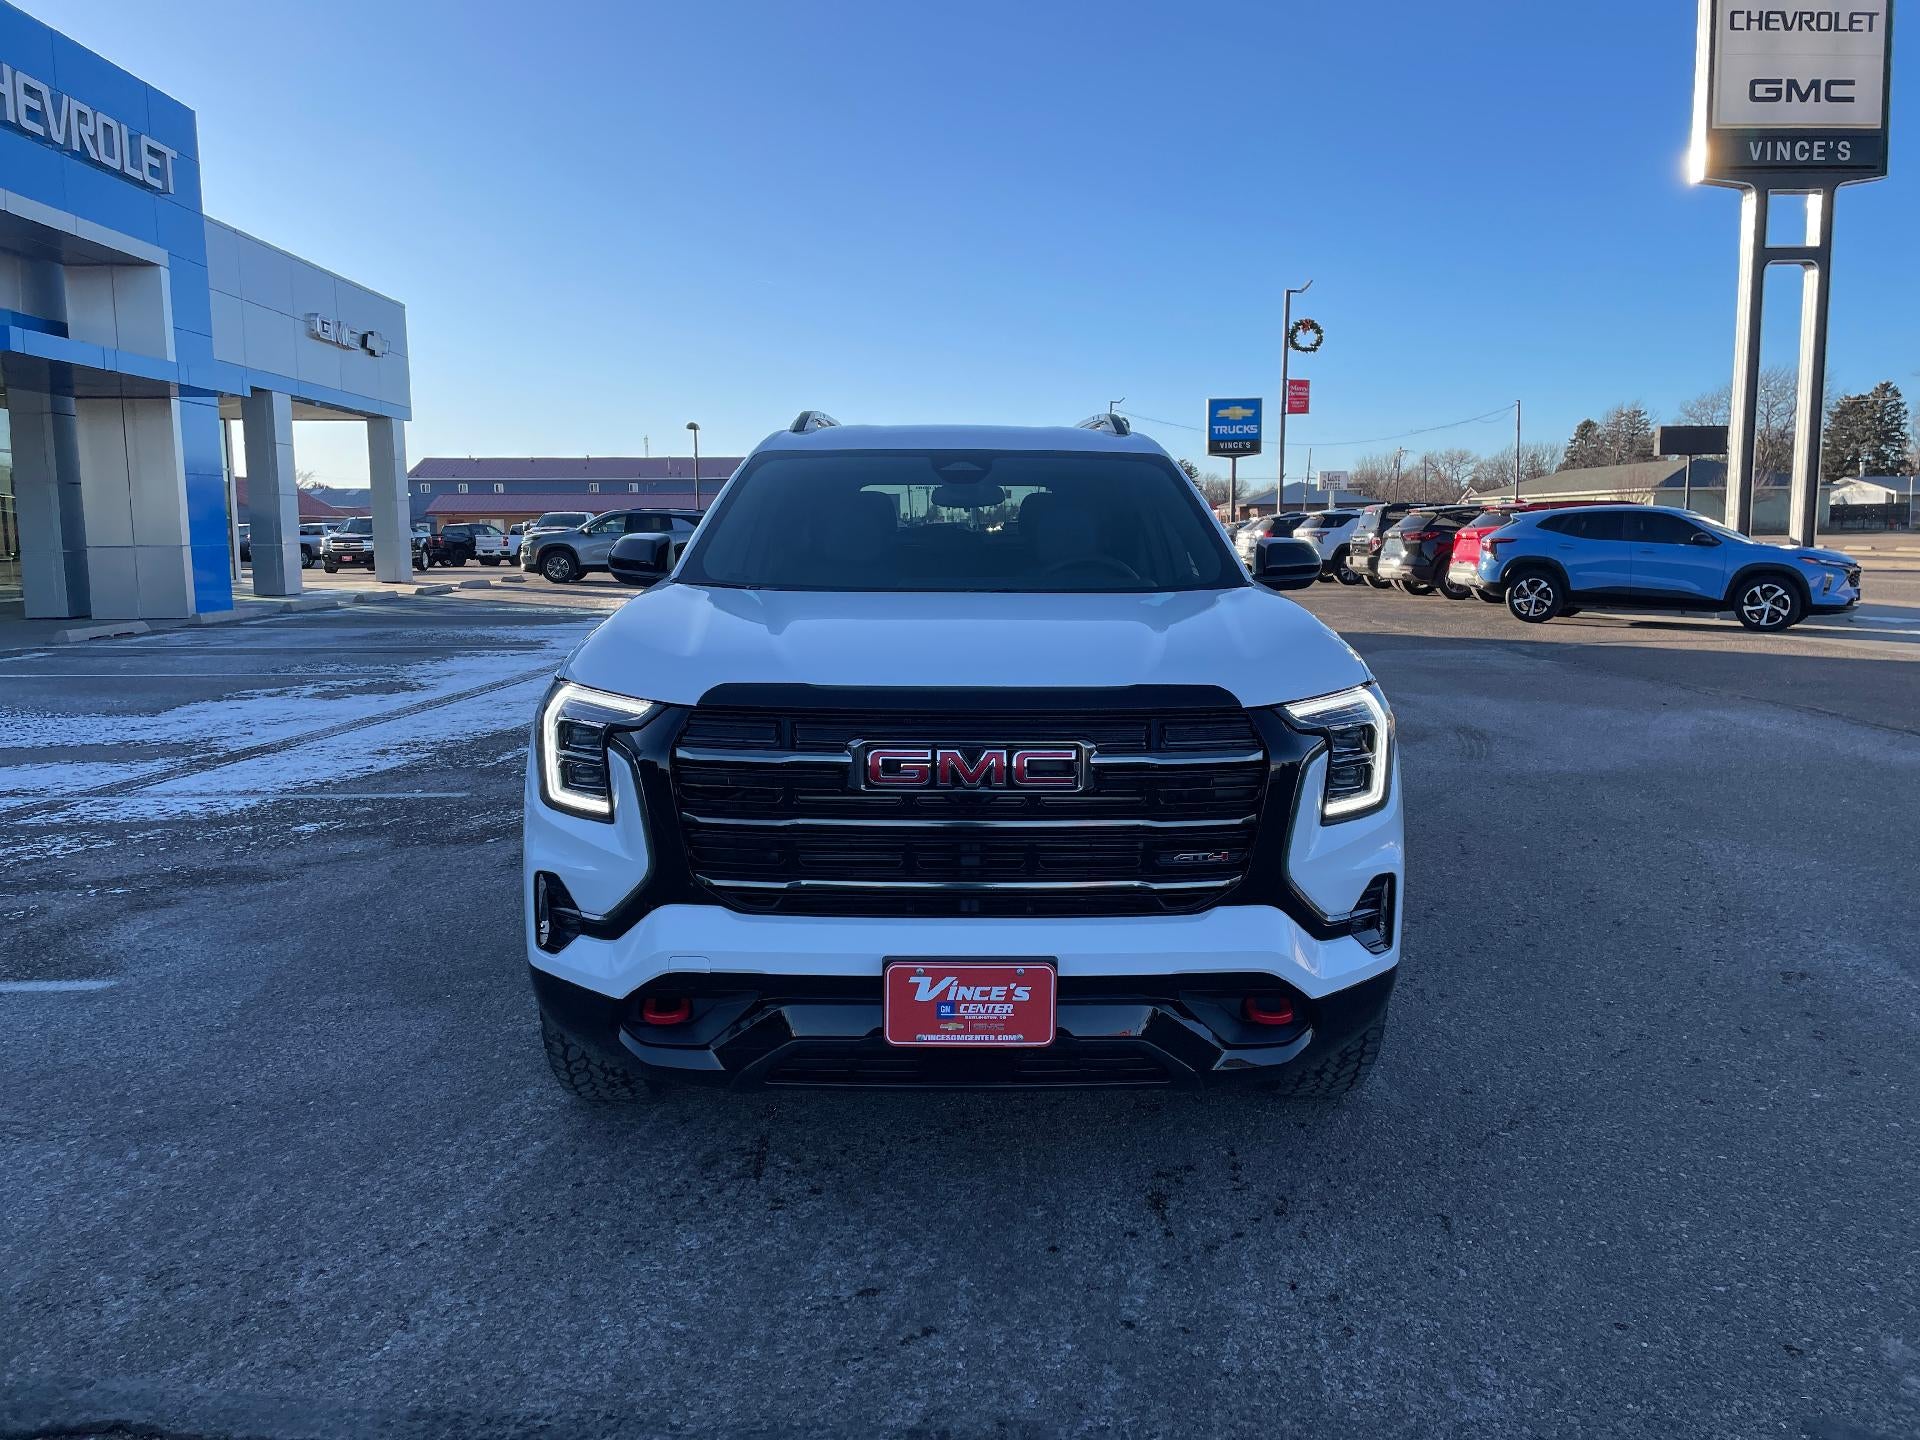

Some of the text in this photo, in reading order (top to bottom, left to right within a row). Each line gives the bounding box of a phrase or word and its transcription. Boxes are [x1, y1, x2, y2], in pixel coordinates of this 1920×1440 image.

[1729, 10, 1880, 32] CHEVROLET
[1748, 78, 1856, 103] GMC
[1749, 141, 1851, 161] VINCE'S
[313, 312, 361, 351] GMC
[1212, 425, 1258, 434] TRUCKS
[1219, 441, 1251, 449] VINCE'S
[867, 748, 1077, 787] GMC
[959, 1003, 1014, 1013] CENTER
